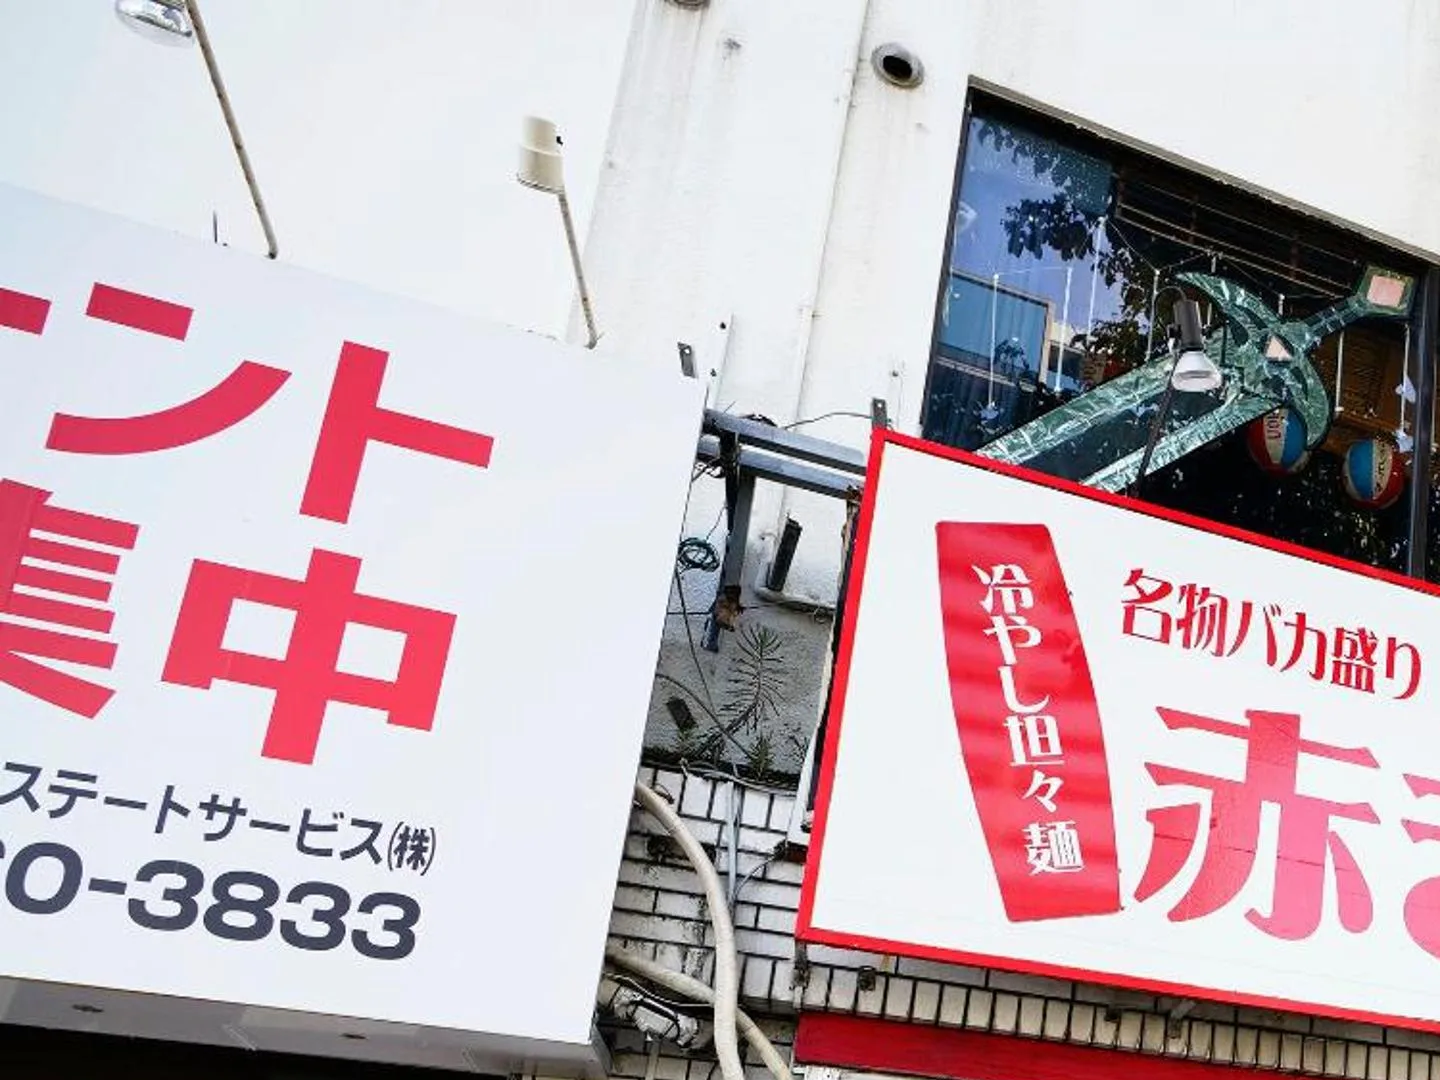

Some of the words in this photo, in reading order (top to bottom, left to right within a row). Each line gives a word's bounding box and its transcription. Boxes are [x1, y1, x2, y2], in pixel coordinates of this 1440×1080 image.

[0, 281, 494, 525] ント
[1120, 567, 1421, 700] 名物バカ盛り
[0, 838, 421, 960] 0-3833
